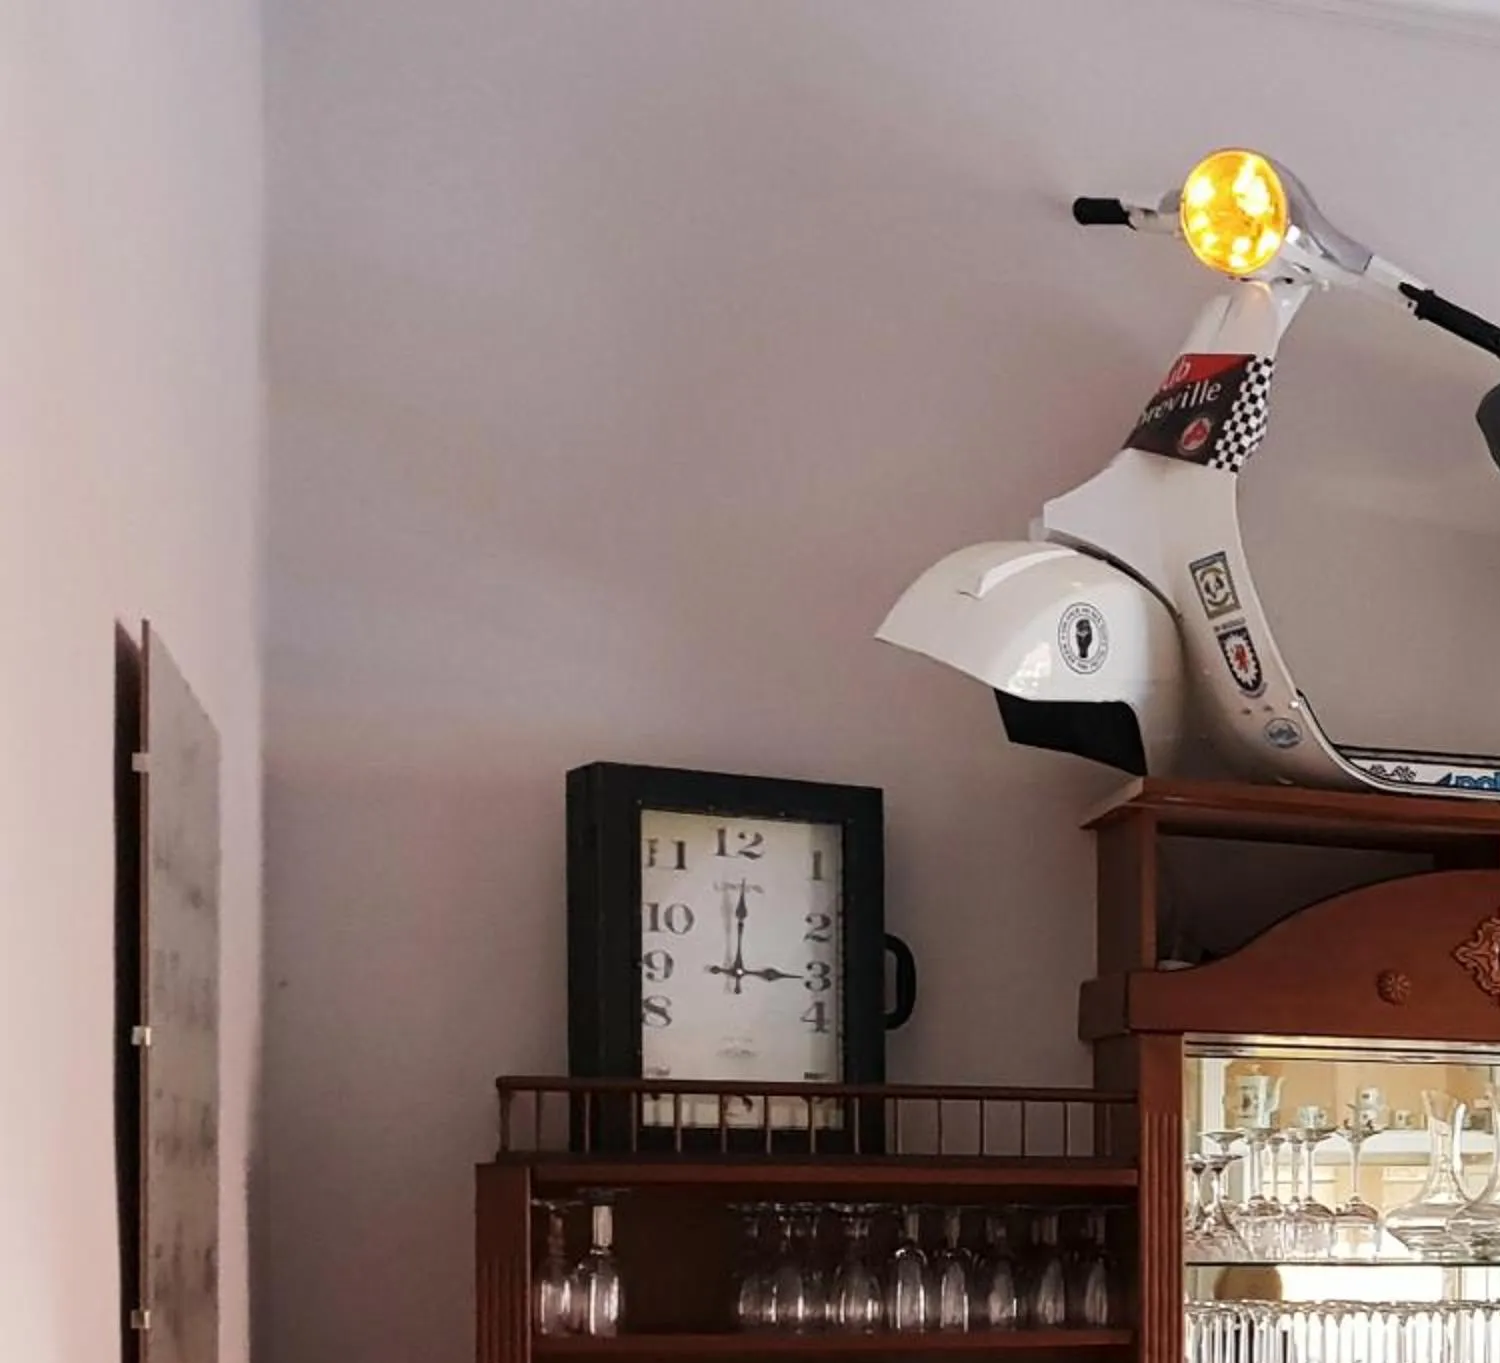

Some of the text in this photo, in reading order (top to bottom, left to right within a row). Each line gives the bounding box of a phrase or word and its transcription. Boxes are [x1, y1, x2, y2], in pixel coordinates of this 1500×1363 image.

[716, 828, 766, 860] 12
[645, 902, 695, 935] 10
[803, 913, 832, 942] 2
[642, 949, 674, 982] 9
[804, 961, 832, 992] 3
[642, 995, 672, 1027] 8
[800, 1001, 831, 1033] 4
